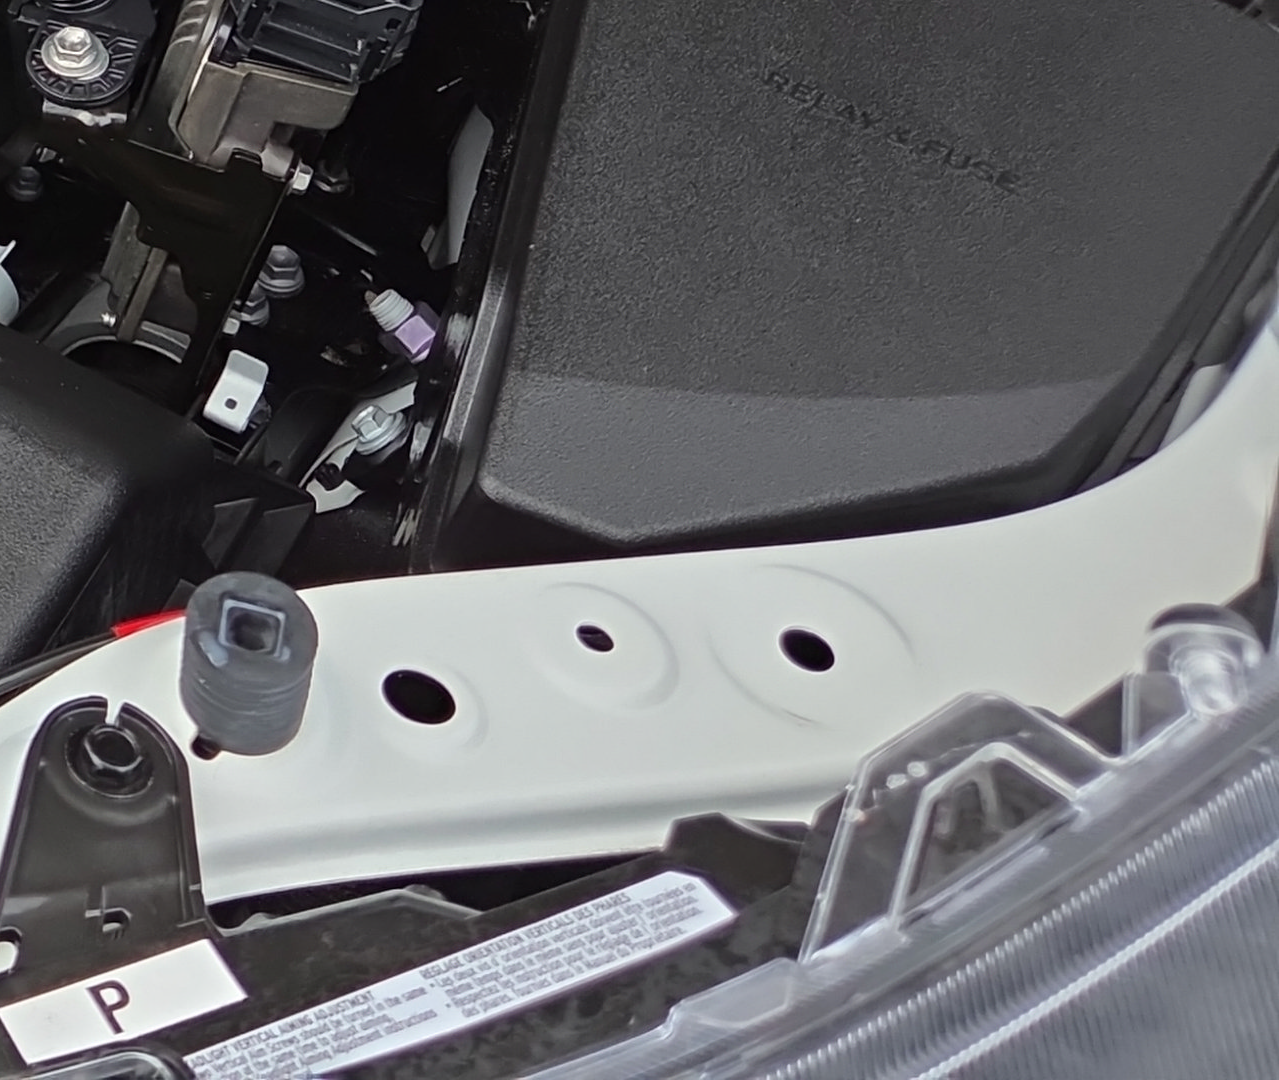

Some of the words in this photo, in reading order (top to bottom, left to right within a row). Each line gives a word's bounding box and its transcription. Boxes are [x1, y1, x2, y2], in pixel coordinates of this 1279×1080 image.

[762, 70, 883, 130] RELAY
[915, 137, 1021, 195] FUSE
[86, 979, 131, 1035] P
[232, 1027, 278, 1052] VERTICAL
[313, 990, 374, 1021] ADJUSTMENT
